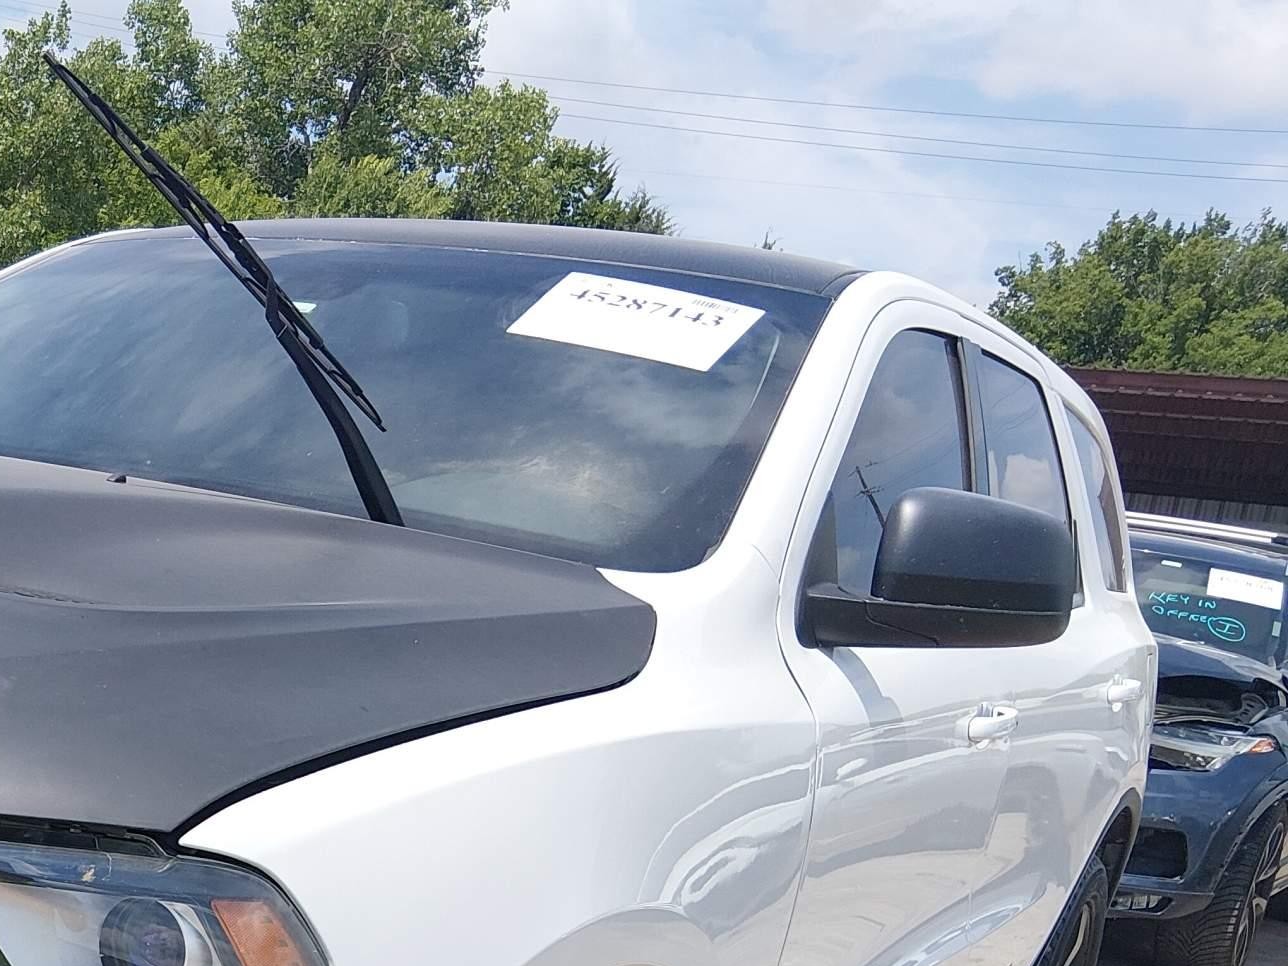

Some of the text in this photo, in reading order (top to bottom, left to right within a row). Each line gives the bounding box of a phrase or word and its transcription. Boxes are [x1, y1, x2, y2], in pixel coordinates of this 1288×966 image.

[570, 289, 724, 327] 45287143
[1149, 592, 1216, 608] KEY IN
